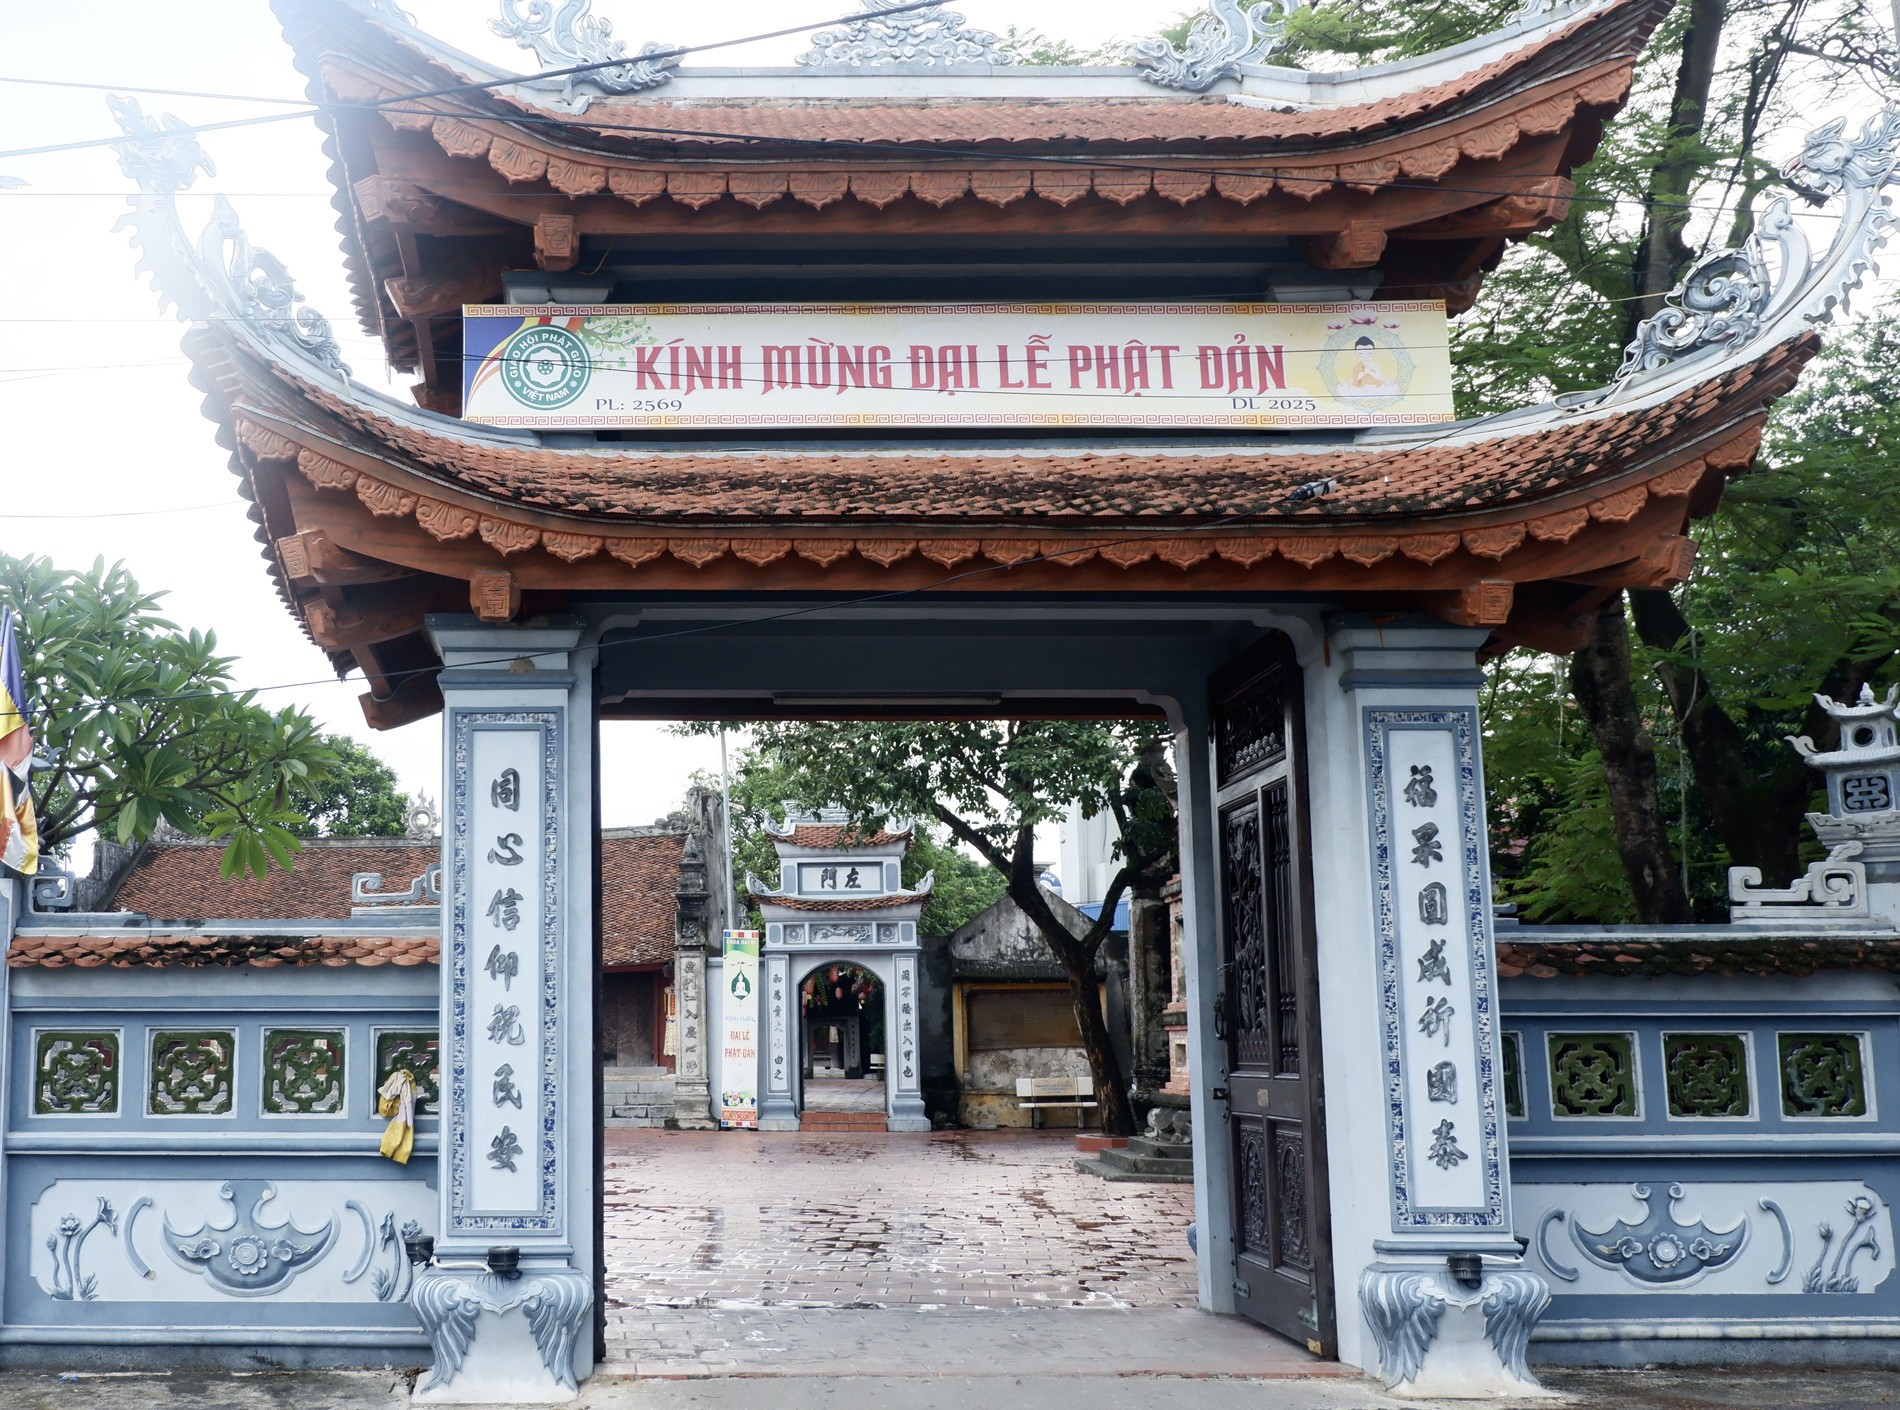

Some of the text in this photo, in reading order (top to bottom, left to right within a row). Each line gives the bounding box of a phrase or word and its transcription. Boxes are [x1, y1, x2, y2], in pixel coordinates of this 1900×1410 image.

[519, 335, 539, 349] HỘI
[542, 333, 573, 349] PHẬT
[634, 333, 1288, 397] KÍNH MỪNG ĐẠI LỄ PHẬT ĐẢN
[522, 386, 570, 402] VIỆT NAM
[595, 398, 683, 412] PL: 2569
[1268, 398, 1317, 411] 2025
